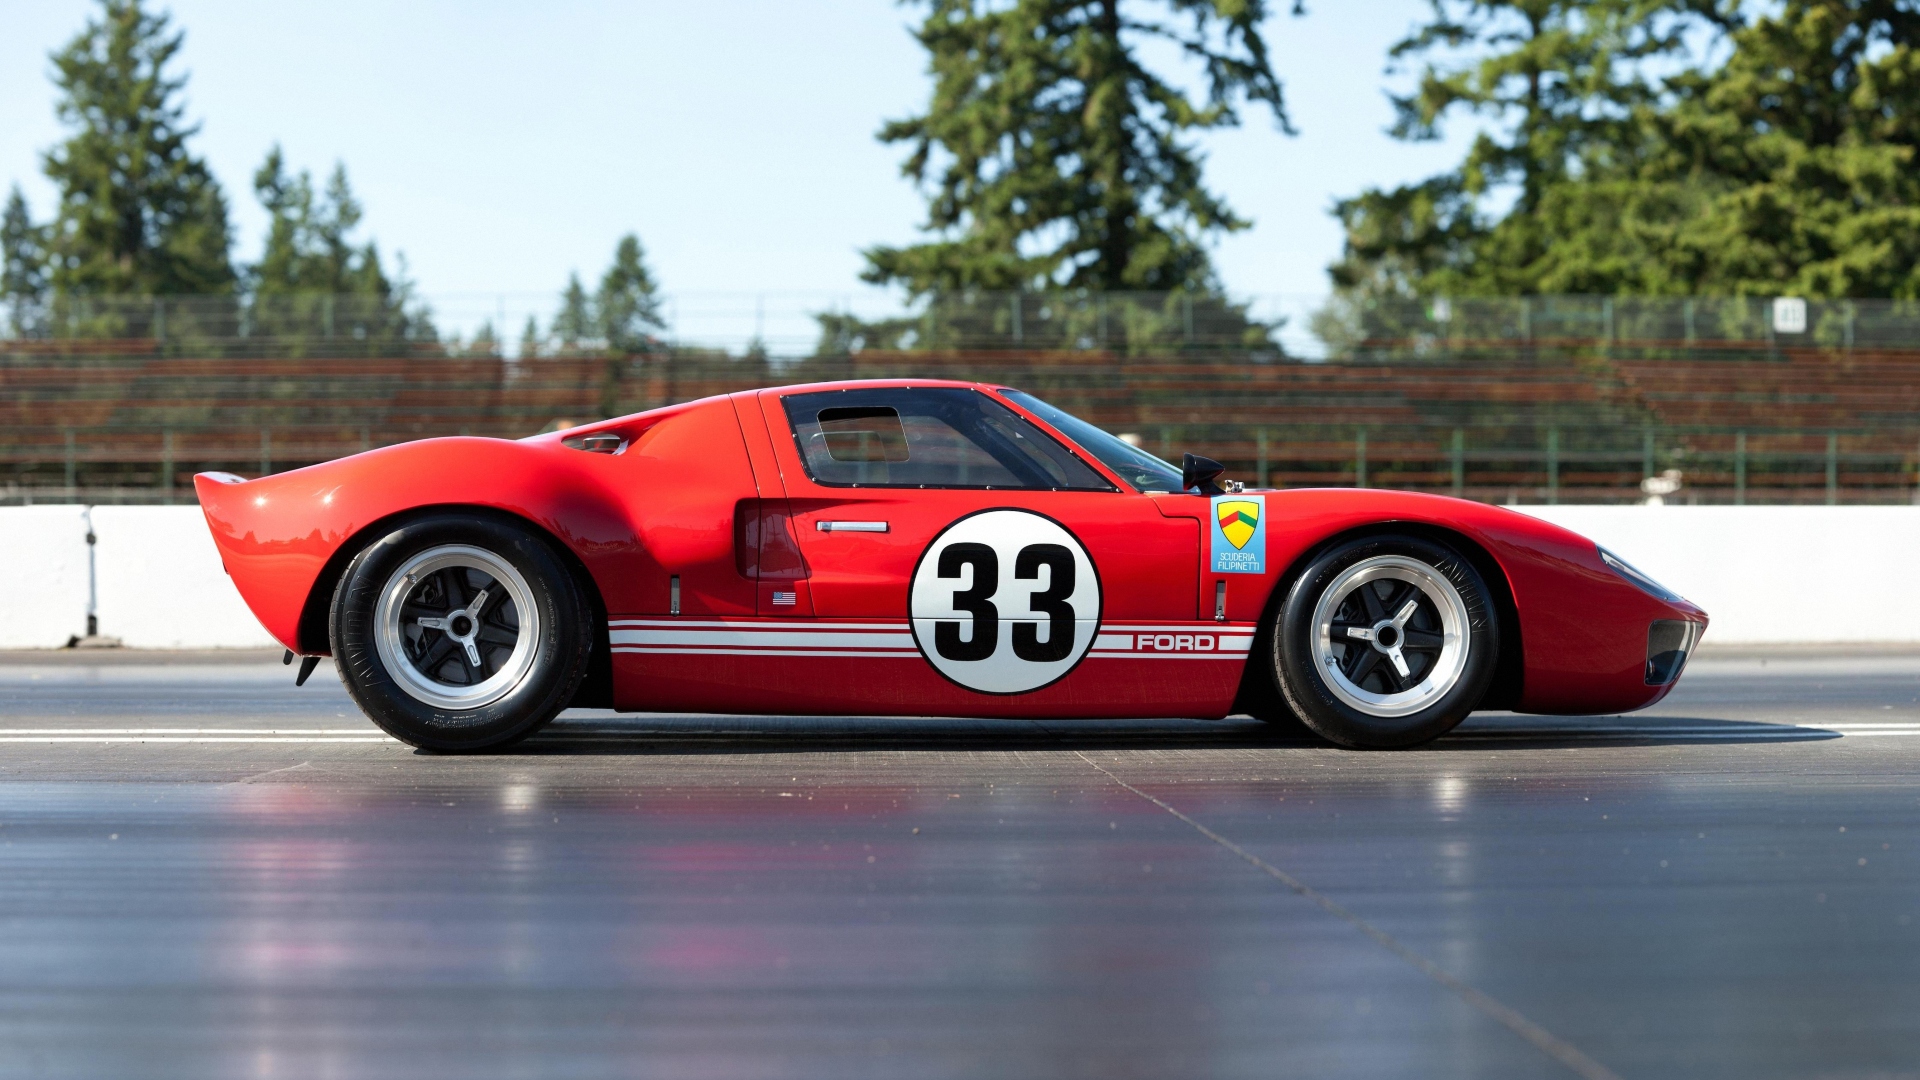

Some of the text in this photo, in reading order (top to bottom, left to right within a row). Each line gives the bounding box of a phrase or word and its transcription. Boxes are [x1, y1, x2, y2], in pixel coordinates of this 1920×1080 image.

[1220, 553, 1256, 561] SCUDERIA
[1218, 562, 1259, 571] FILIPINETTI
[935, 542, 1075, 662] 33
[1137, 634, 1215, 651] FORD
